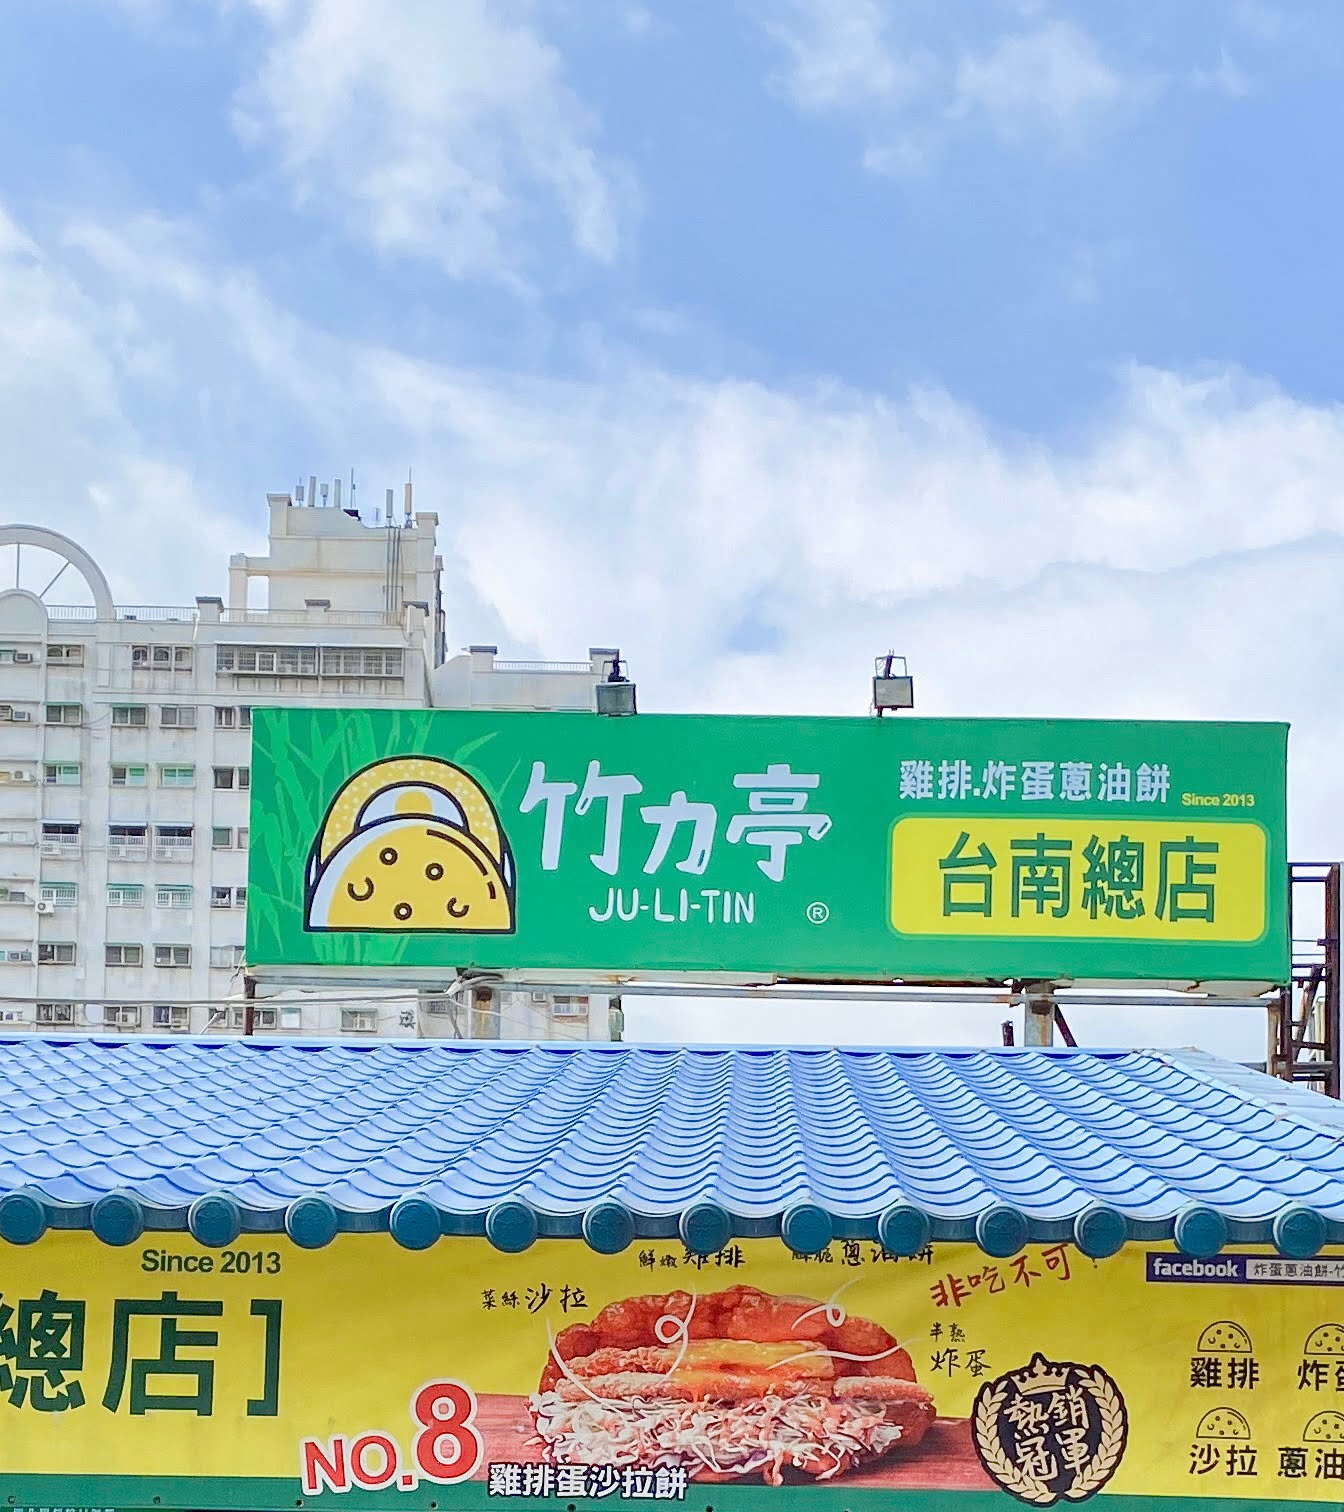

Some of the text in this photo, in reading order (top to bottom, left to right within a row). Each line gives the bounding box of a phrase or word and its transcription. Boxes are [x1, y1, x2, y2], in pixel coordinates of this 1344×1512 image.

[1181, 793, 1255, 807] Since 2013
[519, 760, 832, 882] 竹力亭
[938, 831, 1219, 923] 台南總店
[589, 887, 755, 924] JU-LI-TIN
[141, 1249, 281, 1276] Since 2013
[929, 1242, 1098, 1307] 非吃不可
[1153, 1258, 1239, 1278] facebook
[930, 1347, 991, 1377] 炸蛋
[1190, 1356, 1260, 1390] 雞排
[1188, 1443, 1258, 1477] 沙拉
[488, 1461, 688, 1500] 雞排蛋沙拉餅
